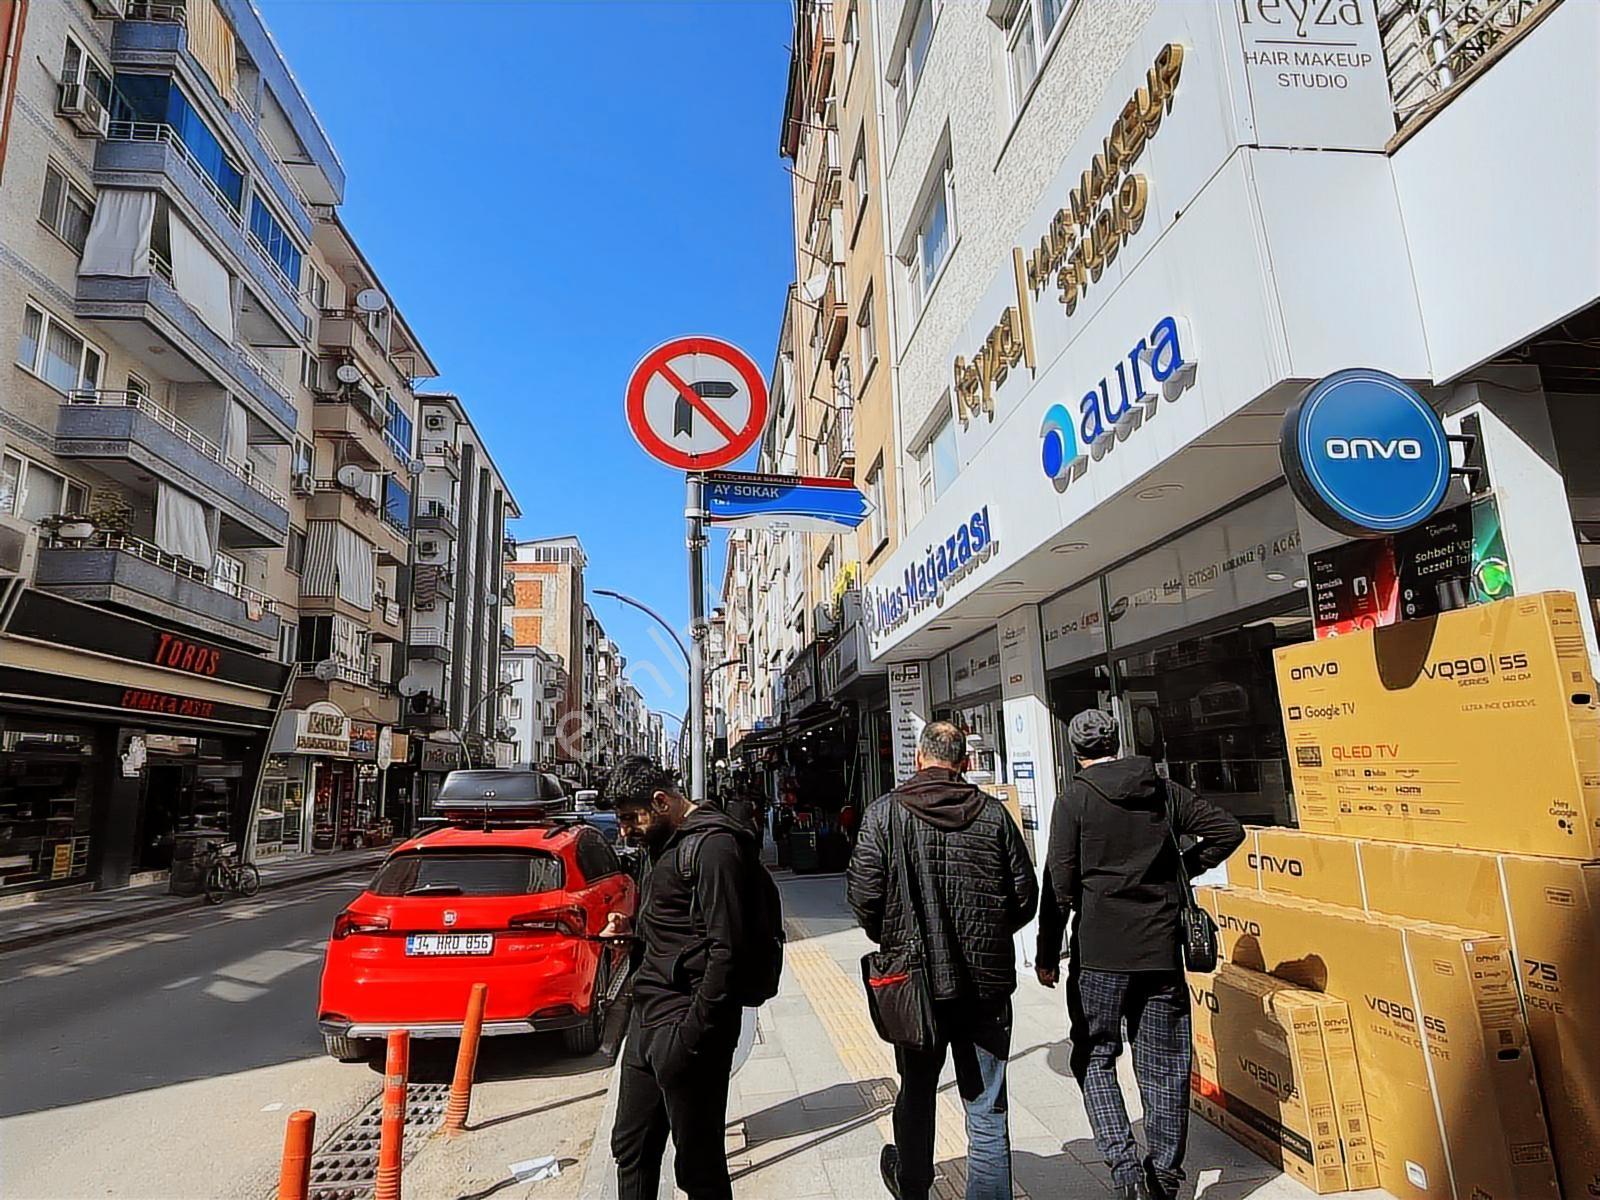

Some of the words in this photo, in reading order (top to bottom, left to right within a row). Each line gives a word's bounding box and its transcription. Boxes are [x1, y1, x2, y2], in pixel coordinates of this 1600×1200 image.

[1246, 52, 1289, 66] HAIR
[1295, 52, 1372, 68] MAKEUP
[1278, 73, 1348, 89] STUDIO
[1059, 173, 1149, 318] STUDIO
[954, 306, 1023, 434] feyza
[1080, 316, 1185, 445] aura
[713, 484, 730, 495] AY
[734, 485, 780, 498] SOKAK
[155, 633, 220, 675] TOROS
[1423, 656, 1486, 680] VQ90
[1499, 653, 1528, 671] 55
[1304, 704, 1341, 720] Google
[1341, 702, 1356, 715] TV
[1332, 745, 1372, 760] QLED
[1376, 744, 1399, 758] TV
[415, 936, 430, 950] 34
[466, 935, 489, 949] 856
[1524, 959, 1559, 982] 75
[1364, 994, 1415, 1023] VQ90
[1423, 1015, 1447, 1034] 65
